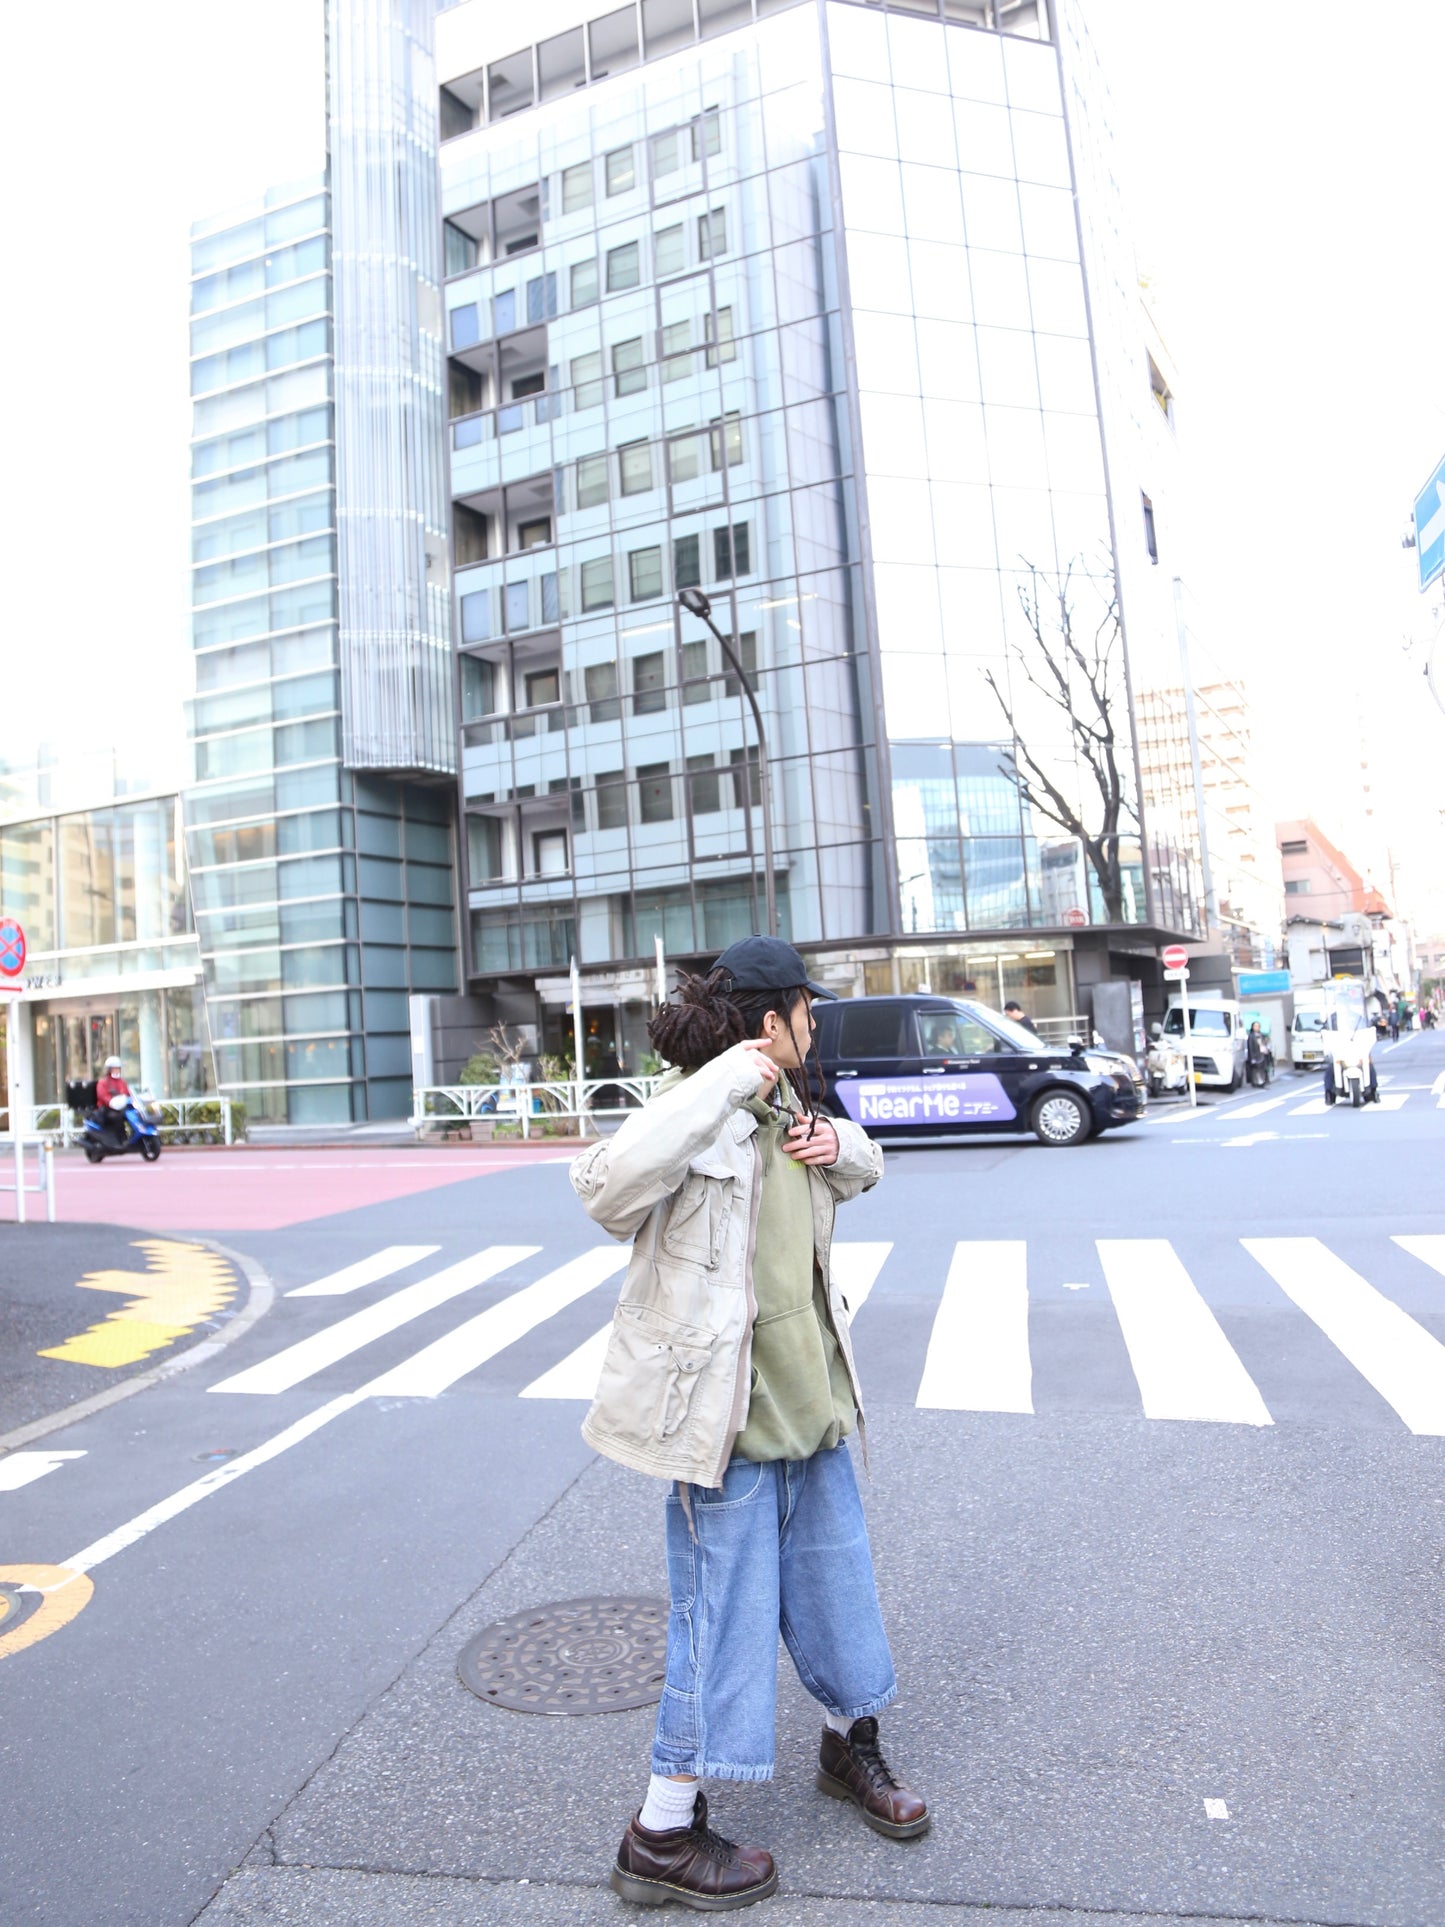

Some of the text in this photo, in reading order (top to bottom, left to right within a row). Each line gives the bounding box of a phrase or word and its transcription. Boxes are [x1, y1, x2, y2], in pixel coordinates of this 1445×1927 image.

[859, 1092, 960, 1119] NearMe
[963, 1102, 999, 1115] ニアミー
